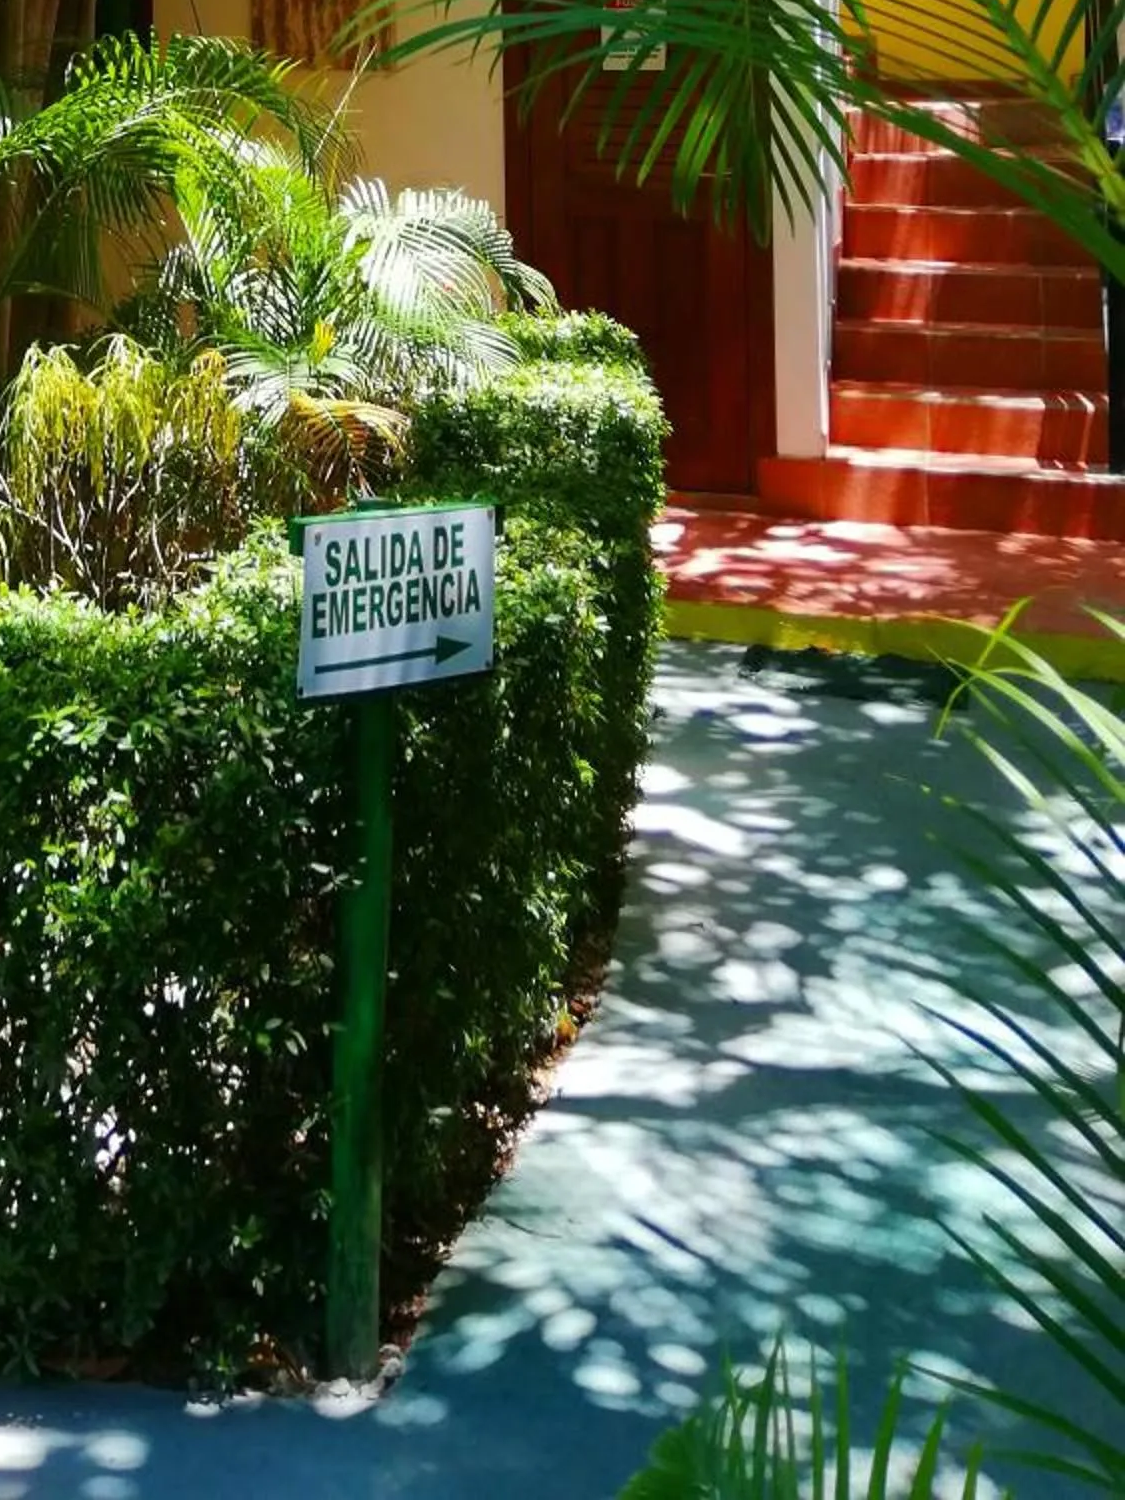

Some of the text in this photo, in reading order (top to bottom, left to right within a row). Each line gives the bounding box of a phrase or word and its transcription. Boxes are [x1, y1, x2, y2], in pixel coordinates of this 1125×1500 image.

[325, 522, 464, 587] SALIDA DE
[312, 569, 481, 639] EMERGENCIA
